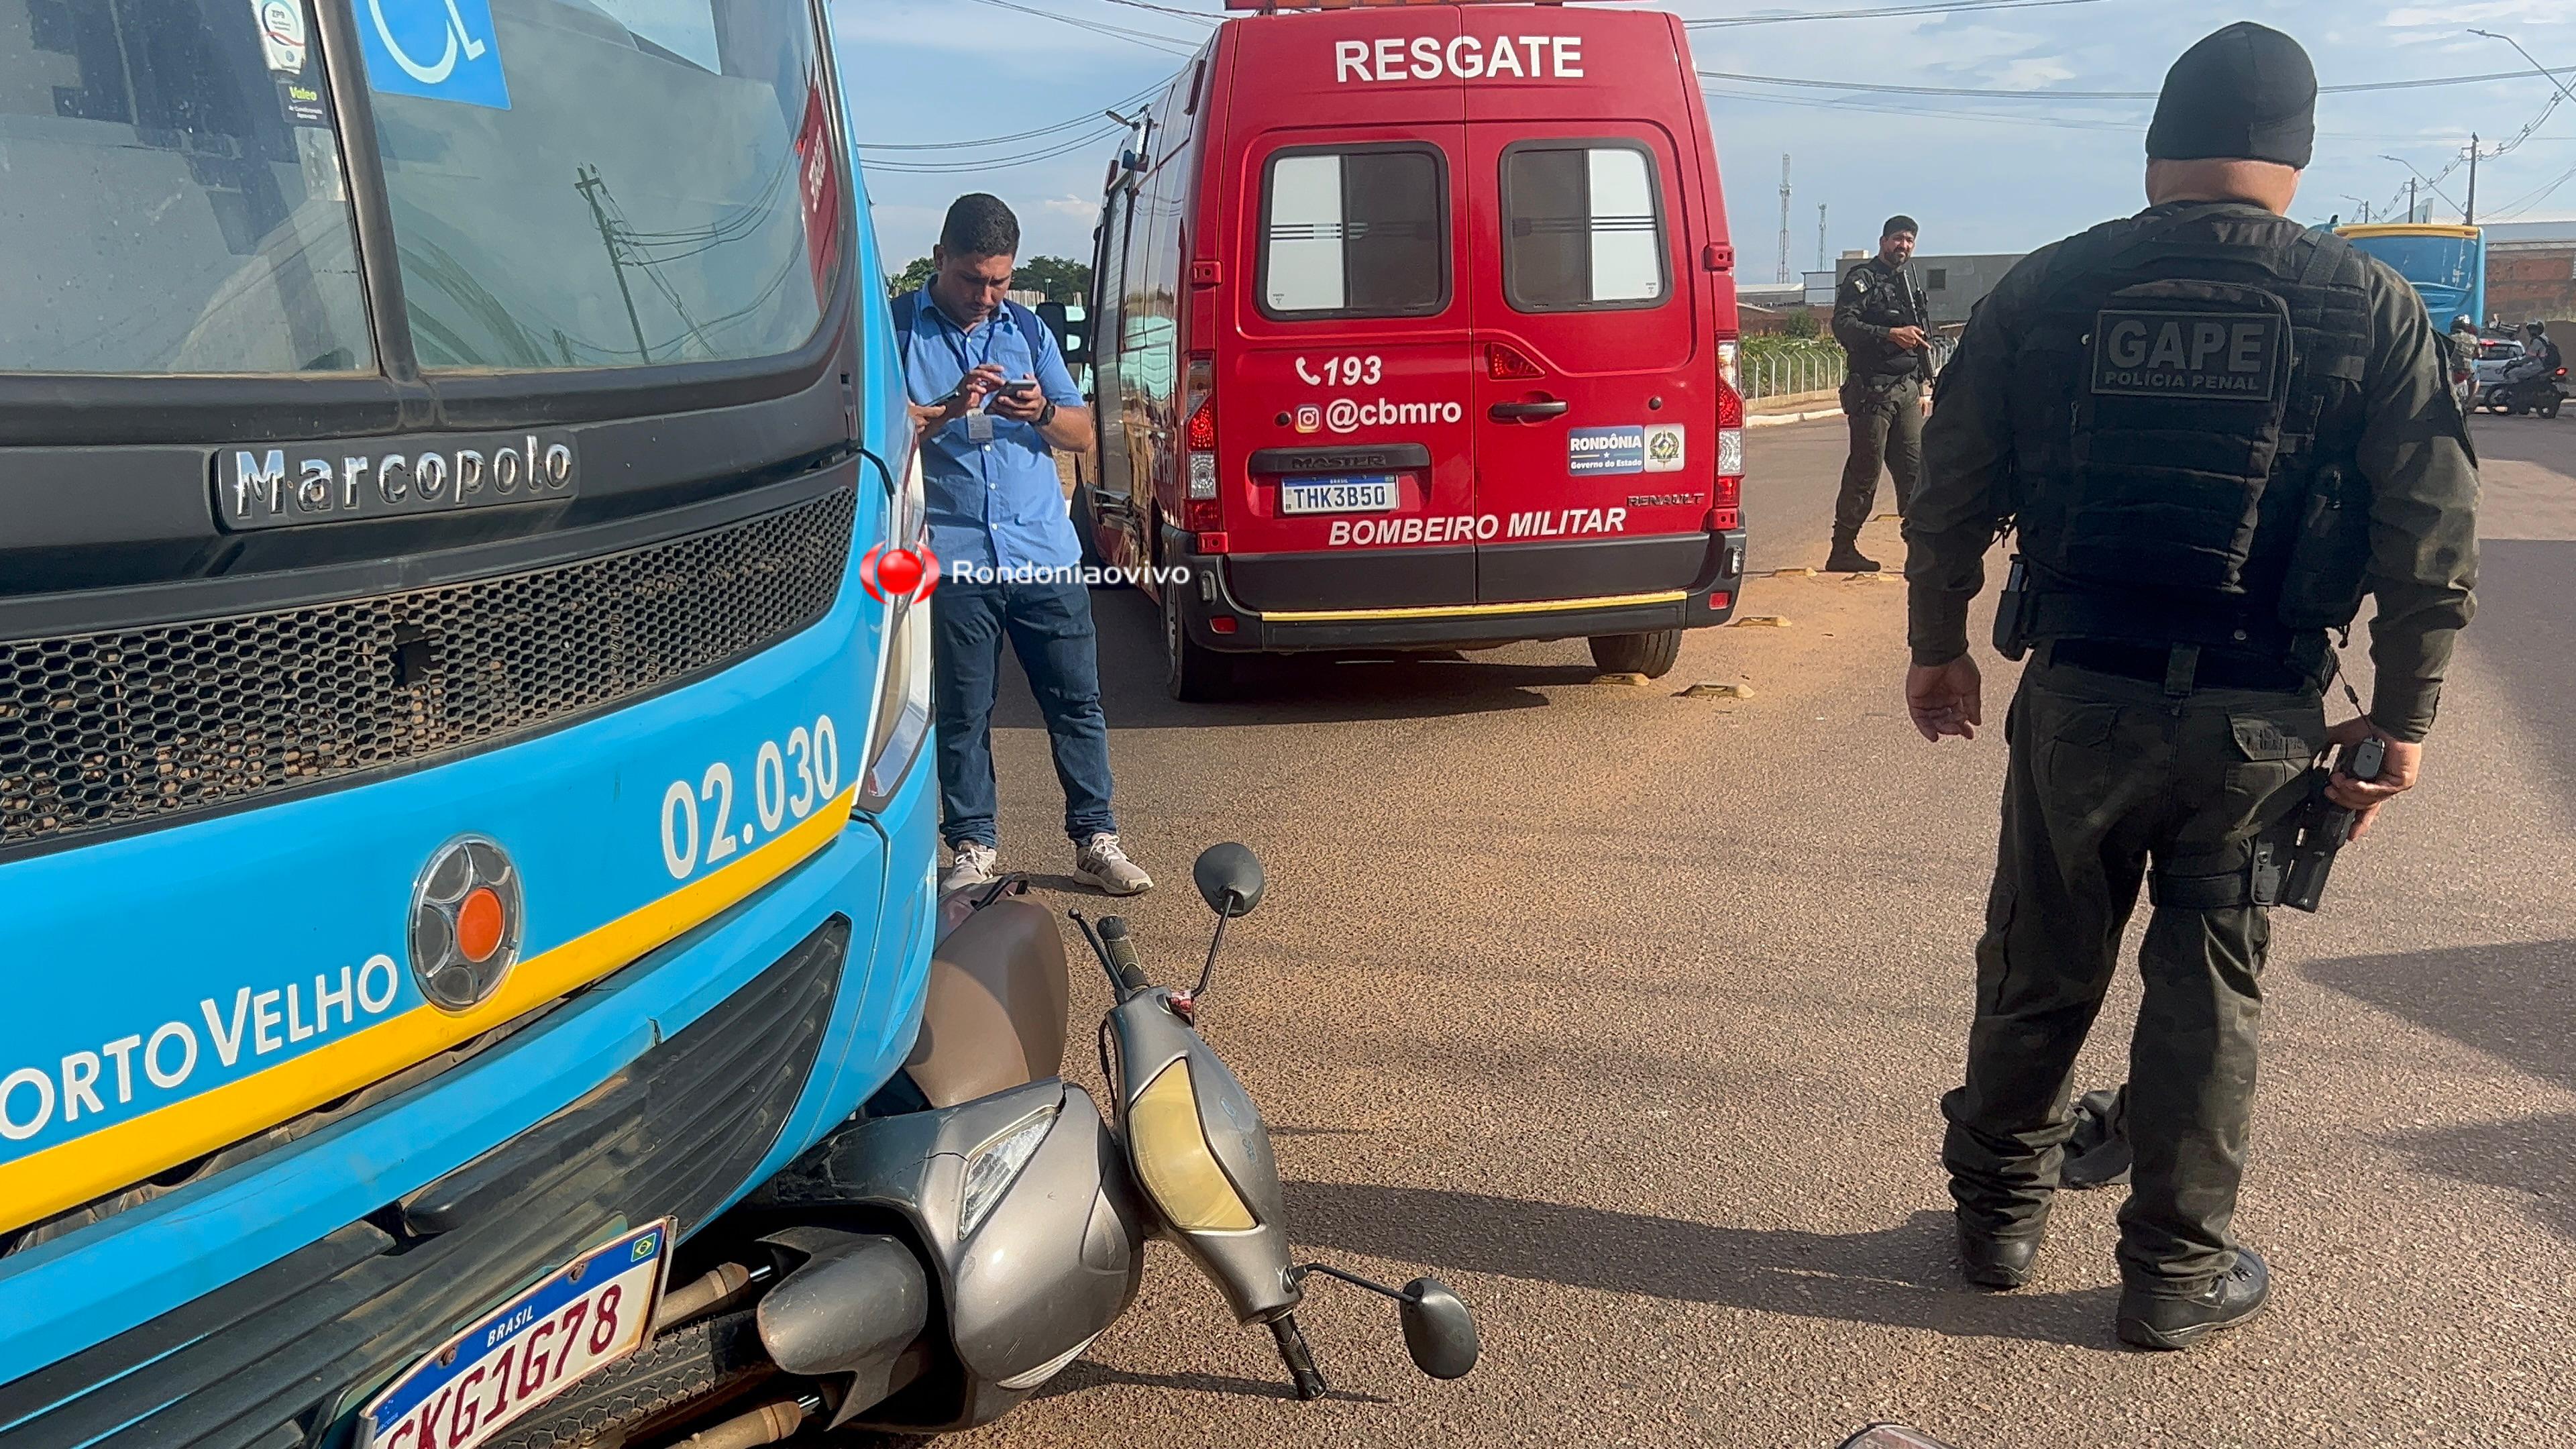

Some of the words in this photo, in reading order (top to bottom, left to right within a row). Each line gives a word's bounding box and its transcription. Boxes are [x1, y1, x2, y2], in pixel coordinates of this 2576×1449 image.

[1335, 36, 1584, 83] RESGATE
[289, 86, 318, 101] Valeo
[2108, 320, 2265, 372] GAPE
[1324, 356, 1382, 386] 193
[2192, 375, 2259, 390] PENAL
[1326, 398, 1462, 433] @cbmro
[1570, 433, 1642, 451] RONDÔNIA
[235, 435, 573, 519] Marcopolo
[1292, 455, 1386, 469] MASTER
[1570, 461, 1603, 470] Governo
[1605, 460, 1615, 468] do
[1617, 459, 1642, 467] Estado
[1293, 486, 1385, 508] THK3B50
[1627, 493, 1705, 507] RENAULT
[1328, 514, 1499, 546] BOMBEIRO
[1507, 508, 1627, 538] MILITAR
[661, 714, 838, 879] 02.030
[486, 1305, 534, 1348] BRASIL
